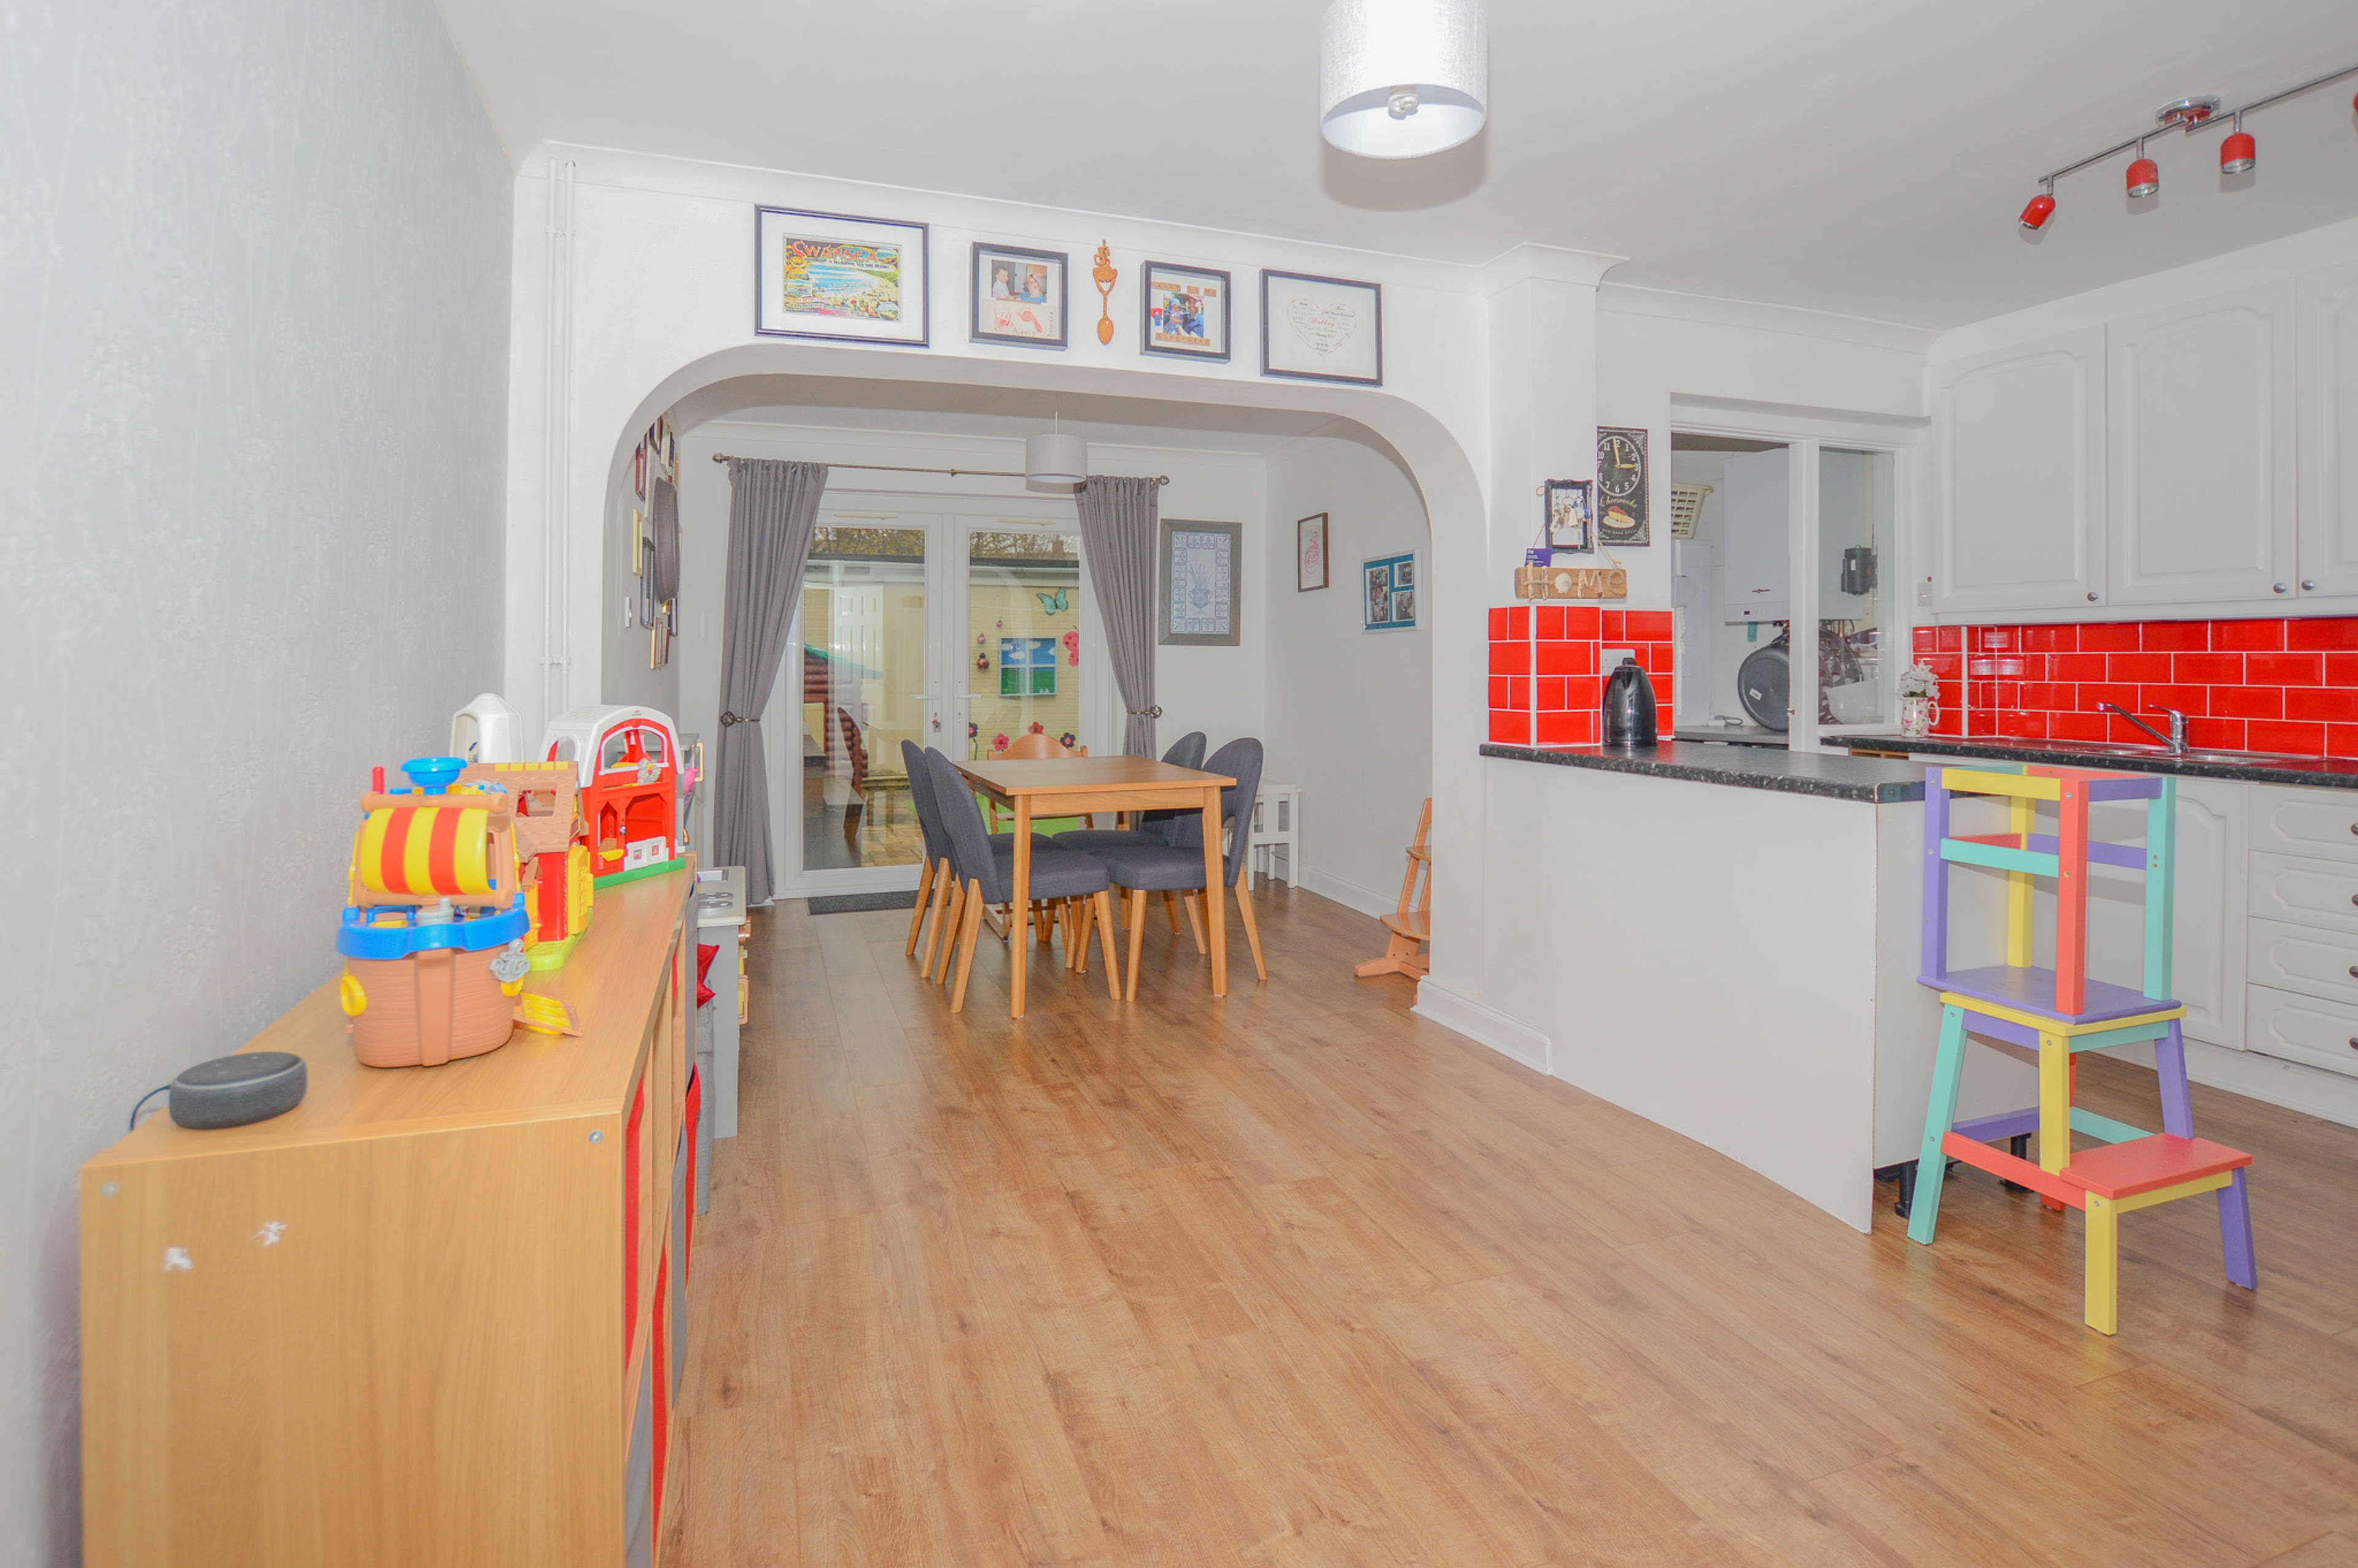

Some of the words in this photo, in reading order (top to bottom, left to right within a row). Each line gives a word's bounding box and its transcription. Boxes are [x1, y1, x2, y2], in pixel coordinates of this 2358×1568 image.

[792, 241, 878, 262] SWANSEA
[1603, 442, 1610, 451] 11
[1625, 443, 1629, 452] 1
[1615, 484, 1620, 493] 6
[1624, 482, 1629, 491] 5
[1600, 495, 1638, 508] Cheesecake
